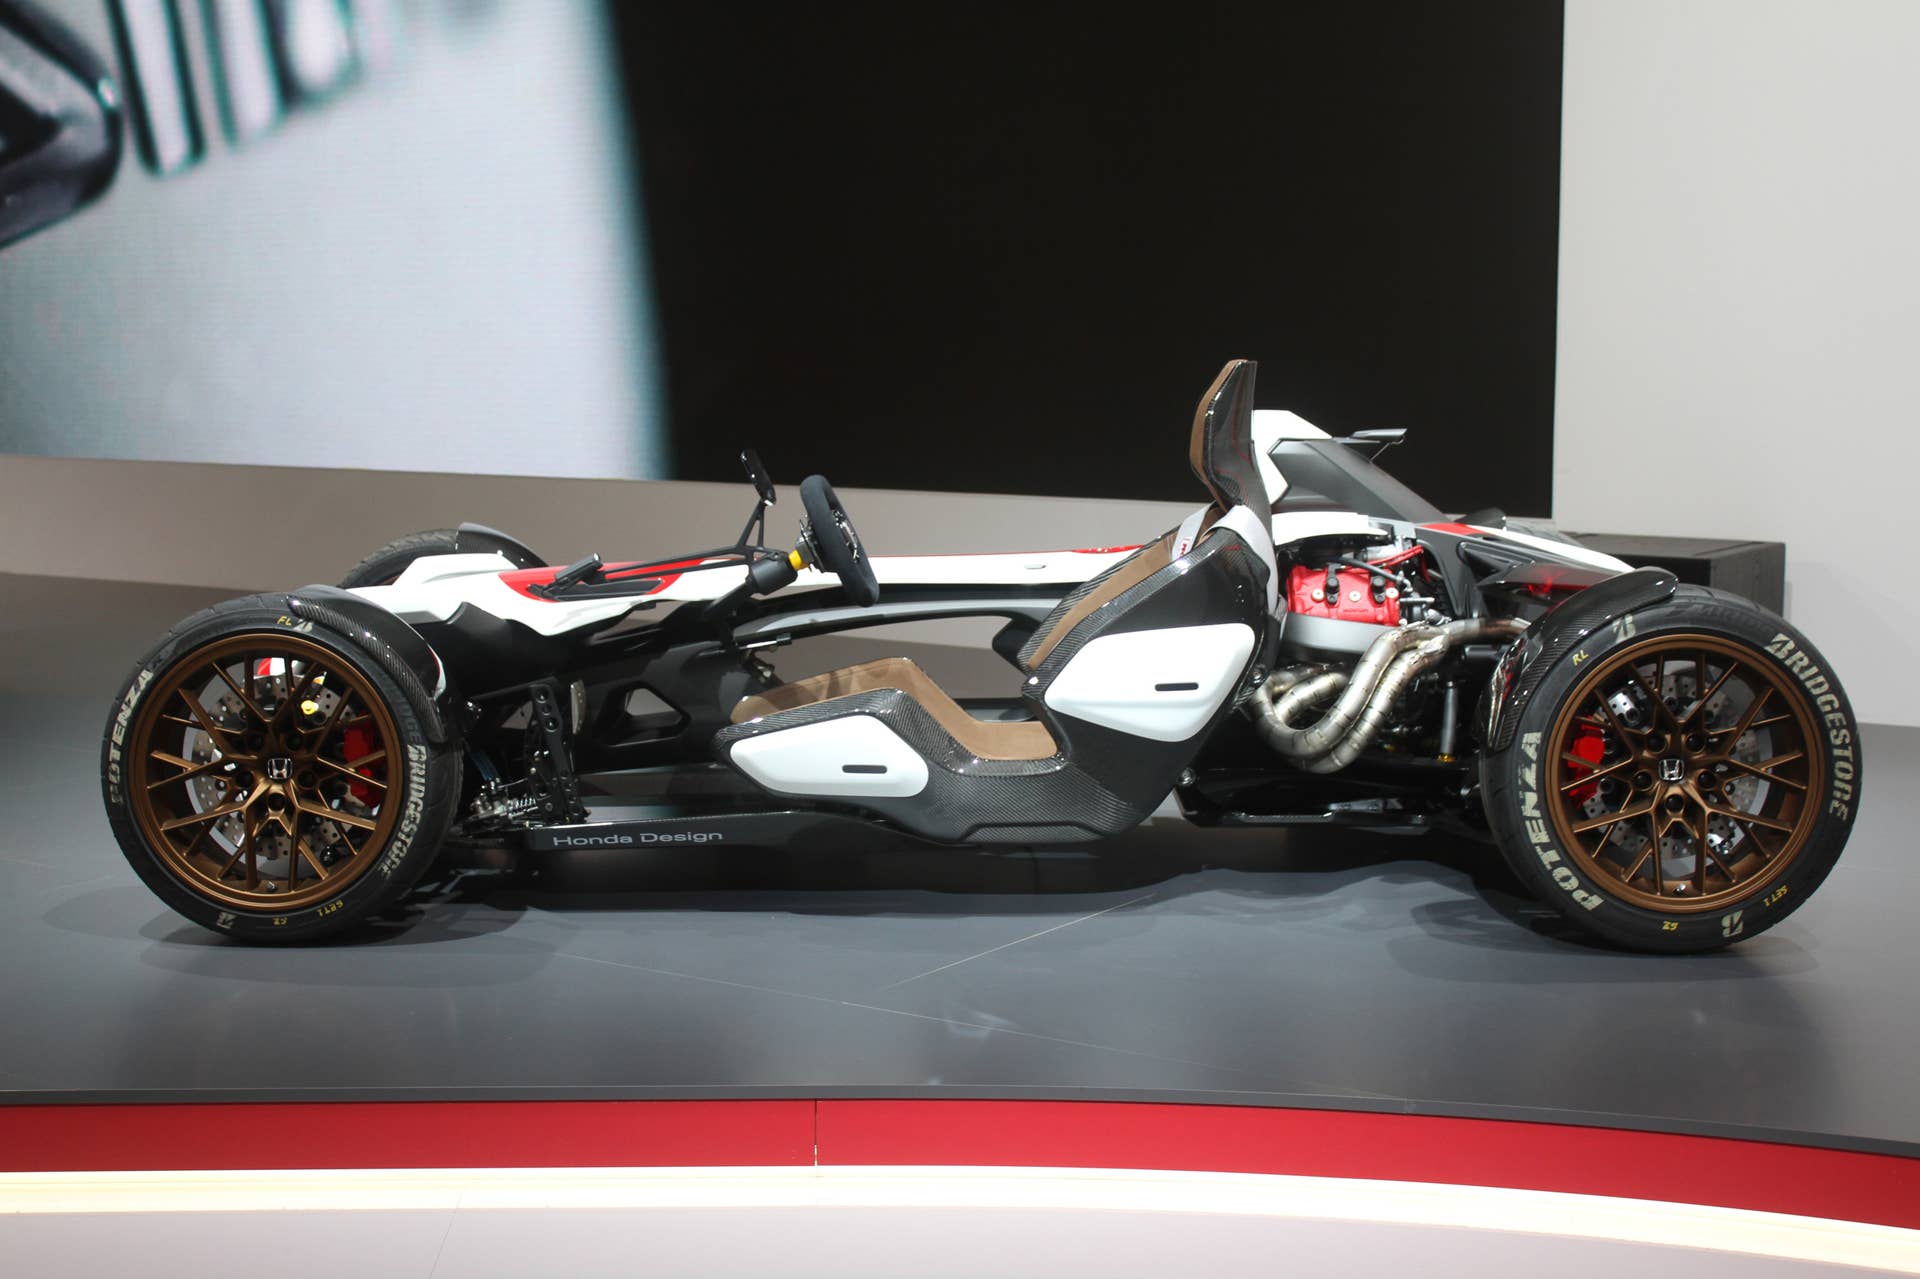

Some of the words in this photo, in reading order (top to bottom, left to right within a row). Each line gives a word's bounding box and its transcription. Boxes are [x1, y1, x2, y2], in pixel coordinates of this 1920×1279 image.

[276, 615, 292, 626] FL
[1572, 649, 1589, 666] RL
[108, 669, 154, 805] POTENZA
[1765, 633, 1853, 821] BRIDGESTONE
[378, 744, 427, 879] BRIDGESTONE
[553, 834, 633, 846] Honda
[640, 831, 723, 843] Design
[1519, 732, 1604, 911] POTENZA
